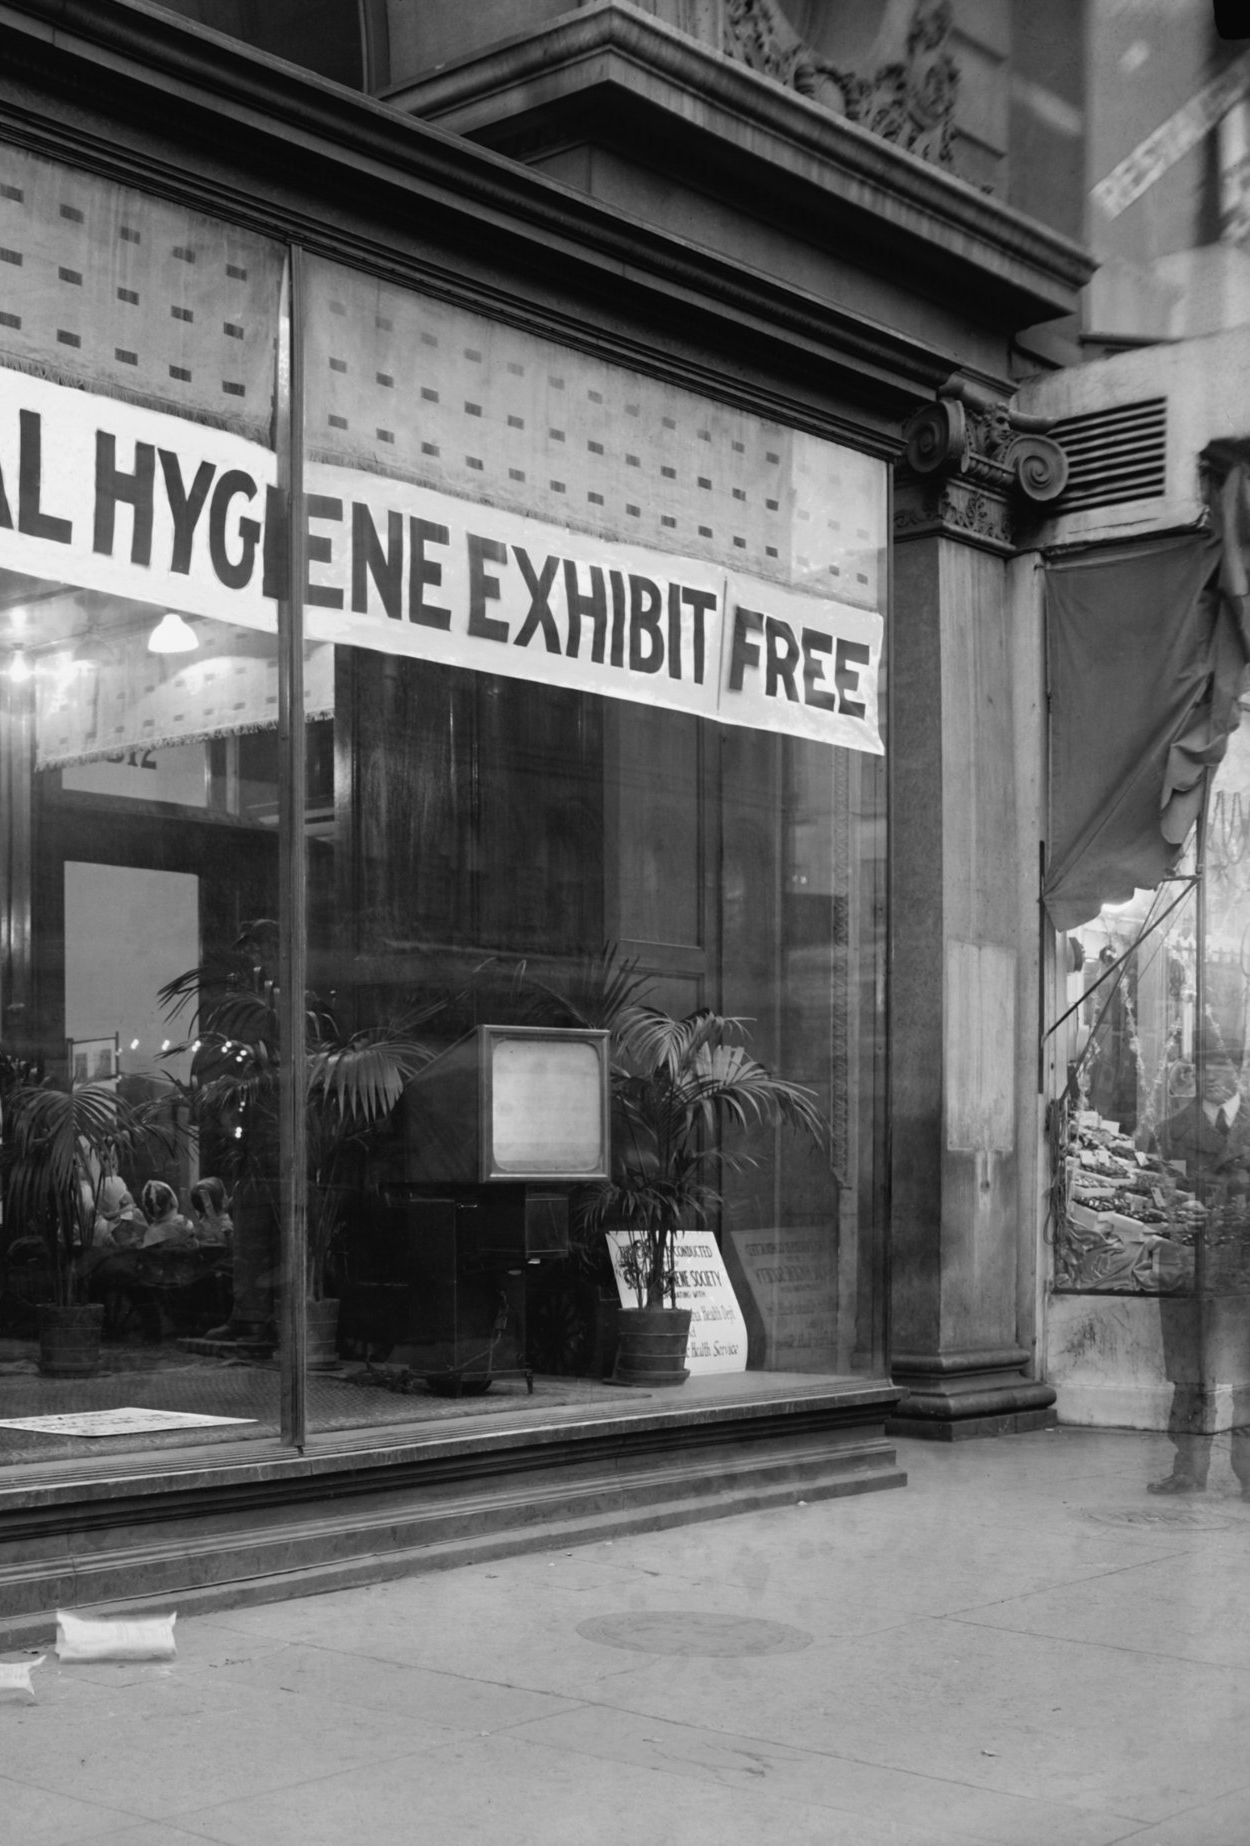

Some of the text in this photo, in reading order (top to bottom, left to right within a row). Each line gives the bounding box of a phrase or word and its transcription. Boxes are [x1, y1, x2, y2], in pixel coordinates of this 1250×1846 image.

[93, 428, 452, 633] HYGIENE
[466, 531, 717, 685] EXHIBIT
[728, 604, 870, 721] FREE
[690, 1270, 722, 1287] SOCIETY
[713, 1340, 739, 1357] Service
